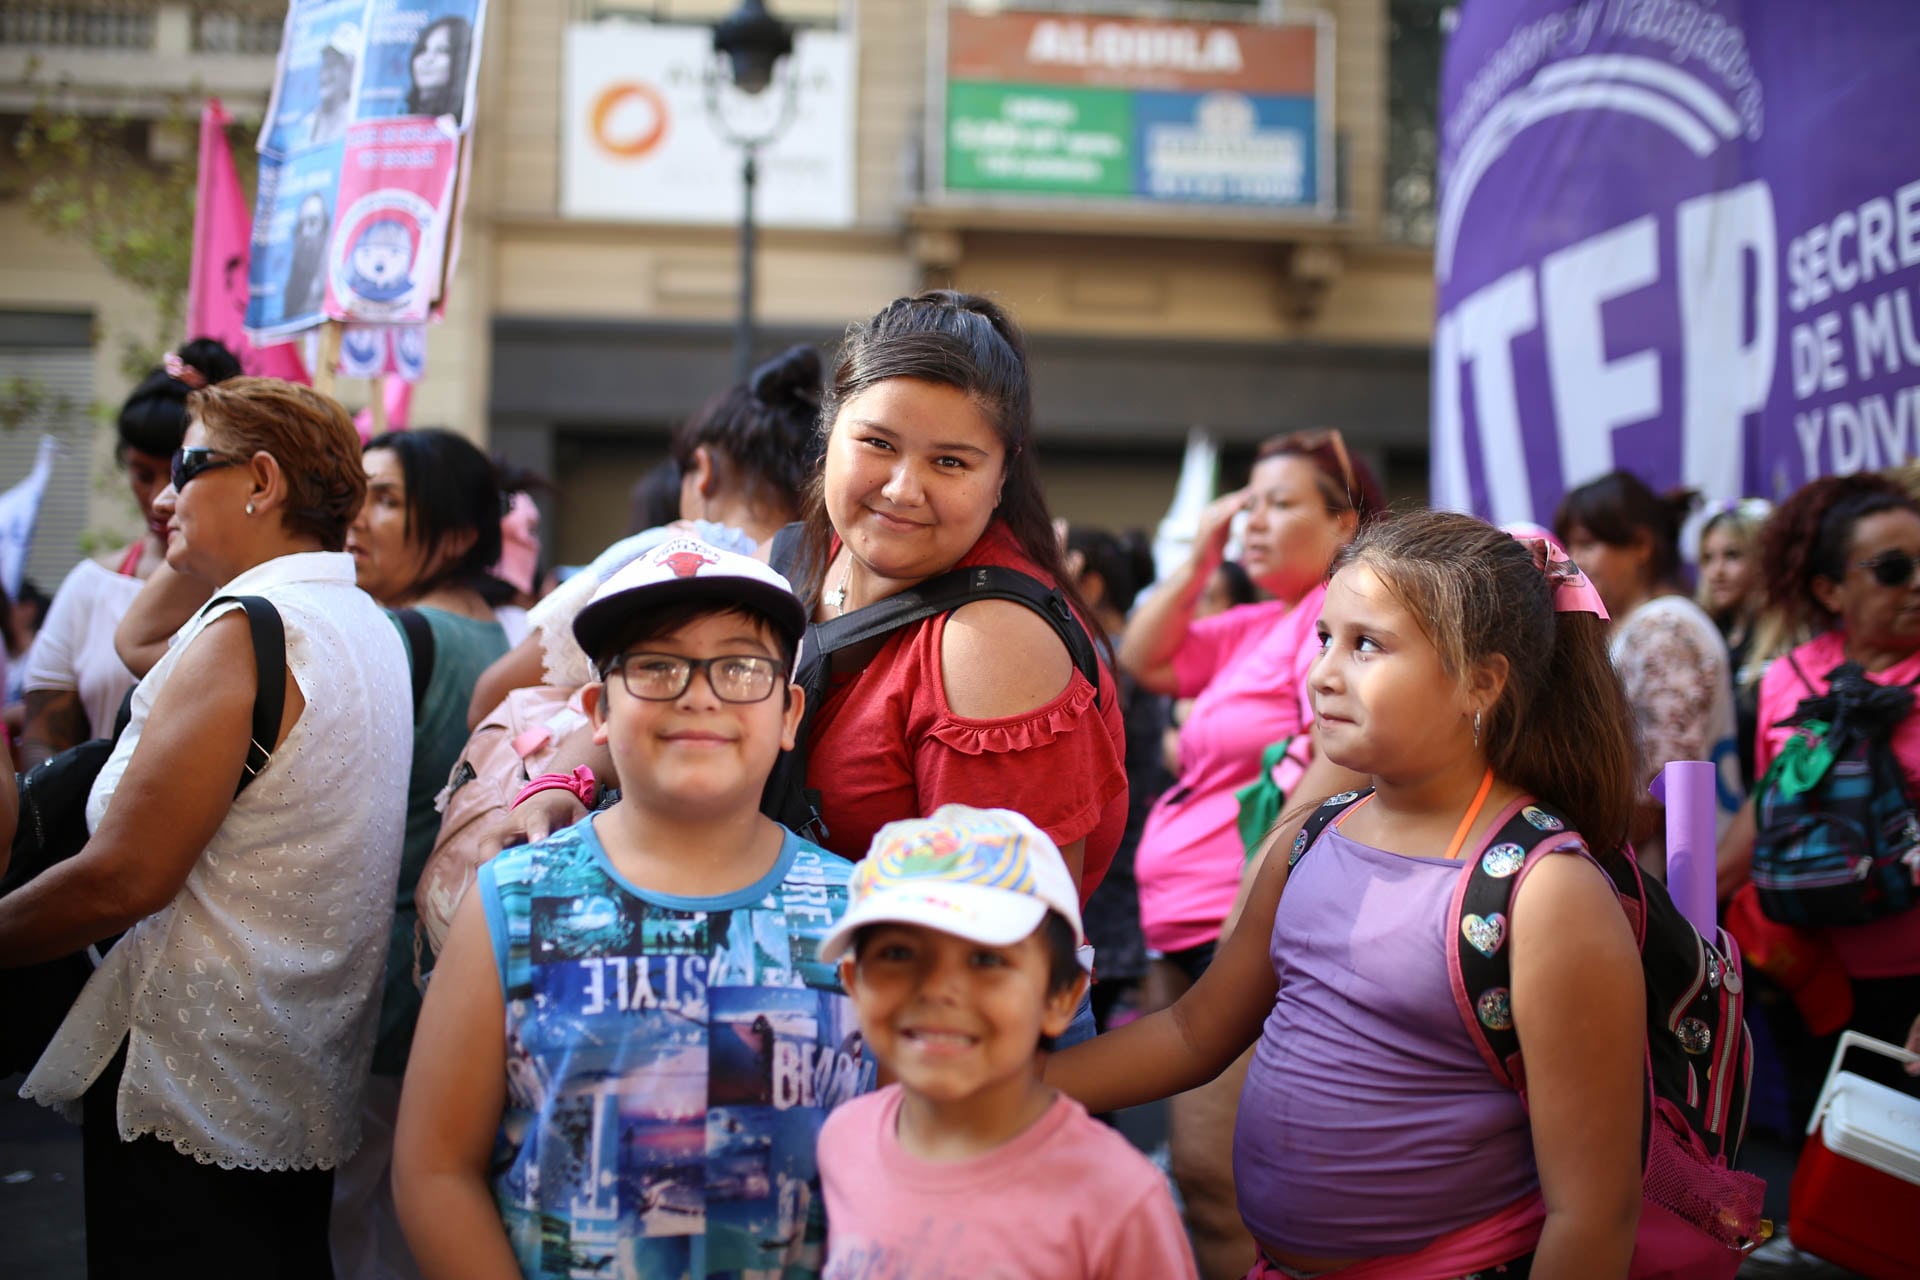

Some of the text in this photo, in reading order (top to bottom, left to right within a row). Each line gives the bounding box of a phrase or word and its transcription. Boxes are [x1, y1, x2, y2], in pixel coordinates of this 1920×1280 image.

[1028, 20, 1243, 72] ALQUILA
[1787, 178, 1920, 314] SECRE
[1790, 310, 1849, 400] DE
[1794, 405, 1824, 482] Y
[579, 954, 708, 1016] STYLE
